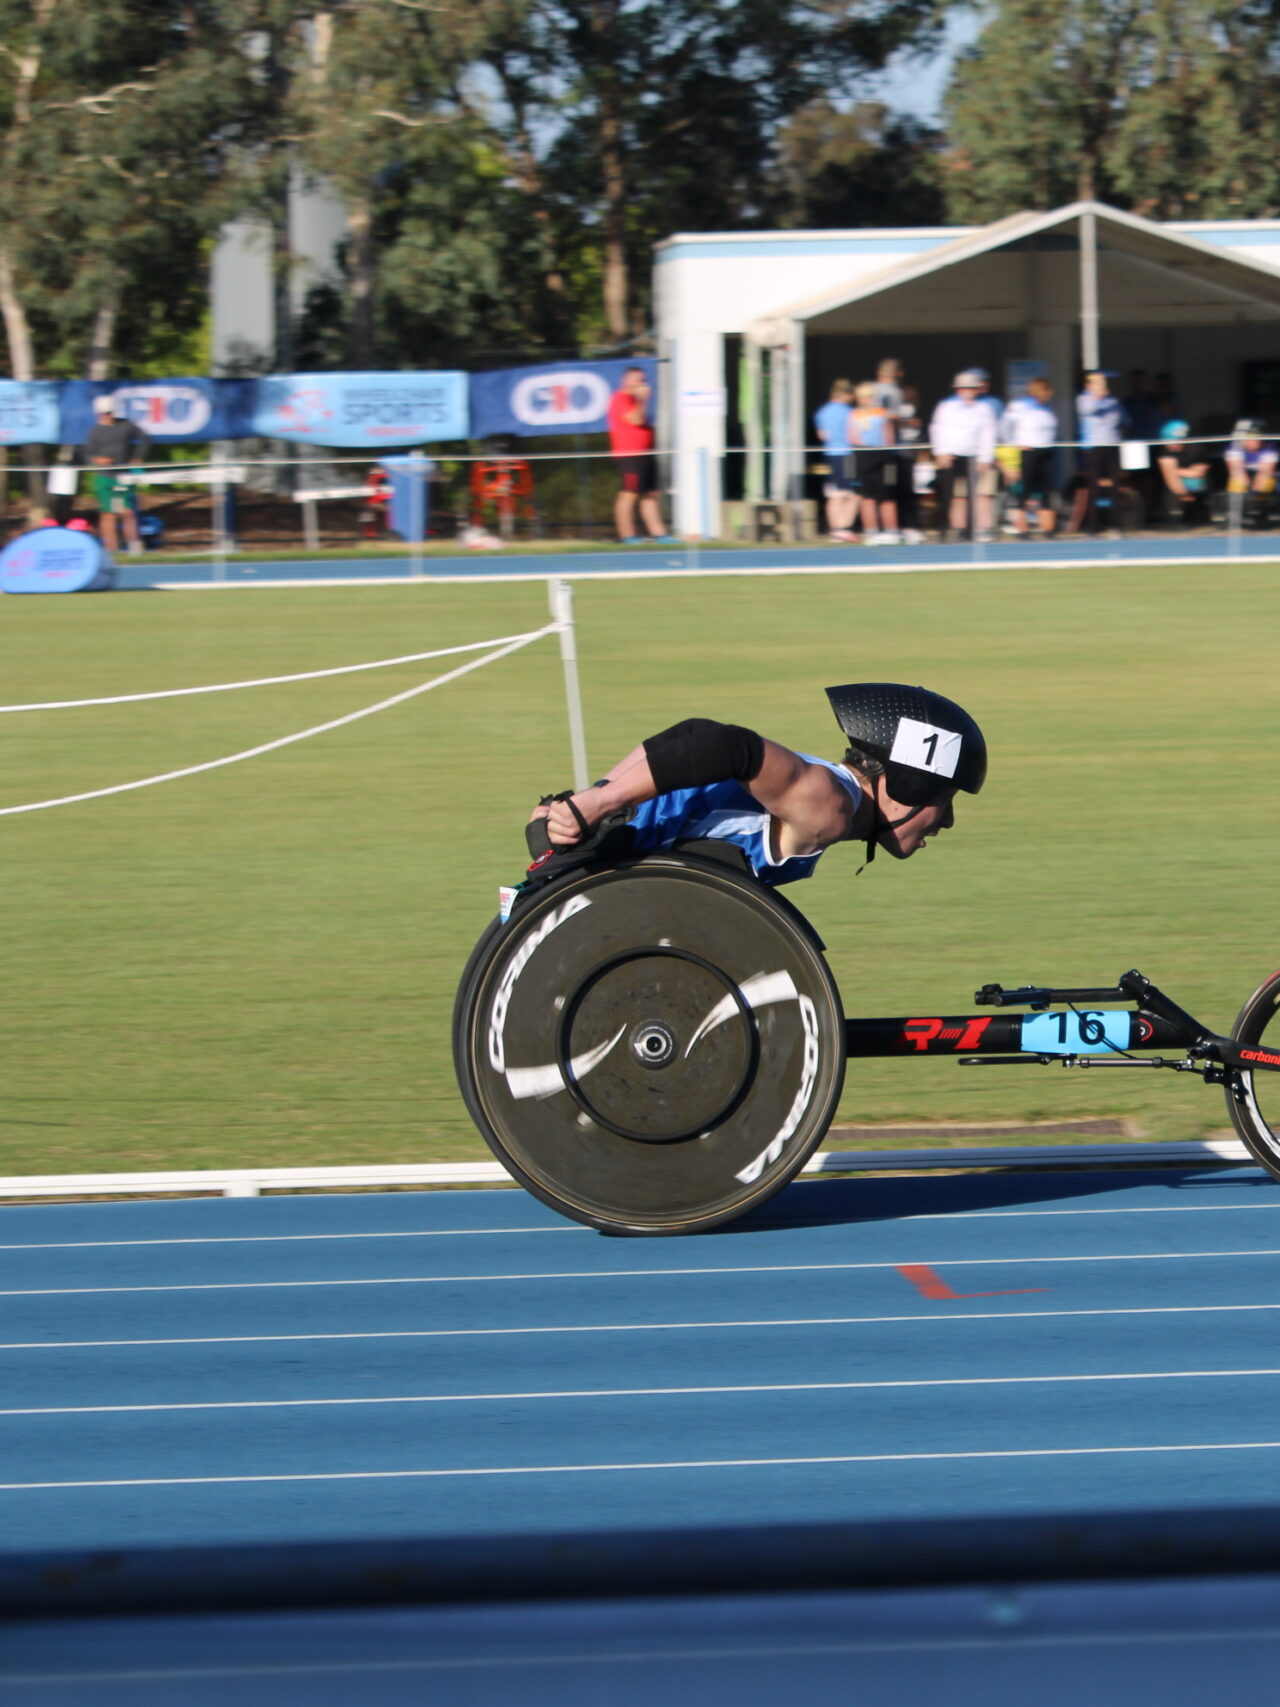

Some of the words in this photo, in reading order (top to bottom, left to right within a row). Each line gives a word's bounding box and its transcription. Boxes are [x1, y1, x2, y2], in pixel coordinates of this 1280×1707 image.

[528, 384, 593, 413] GIO
[922, 732, 939, 767] 1
[1048, 1010, 1106, 1046] 16
